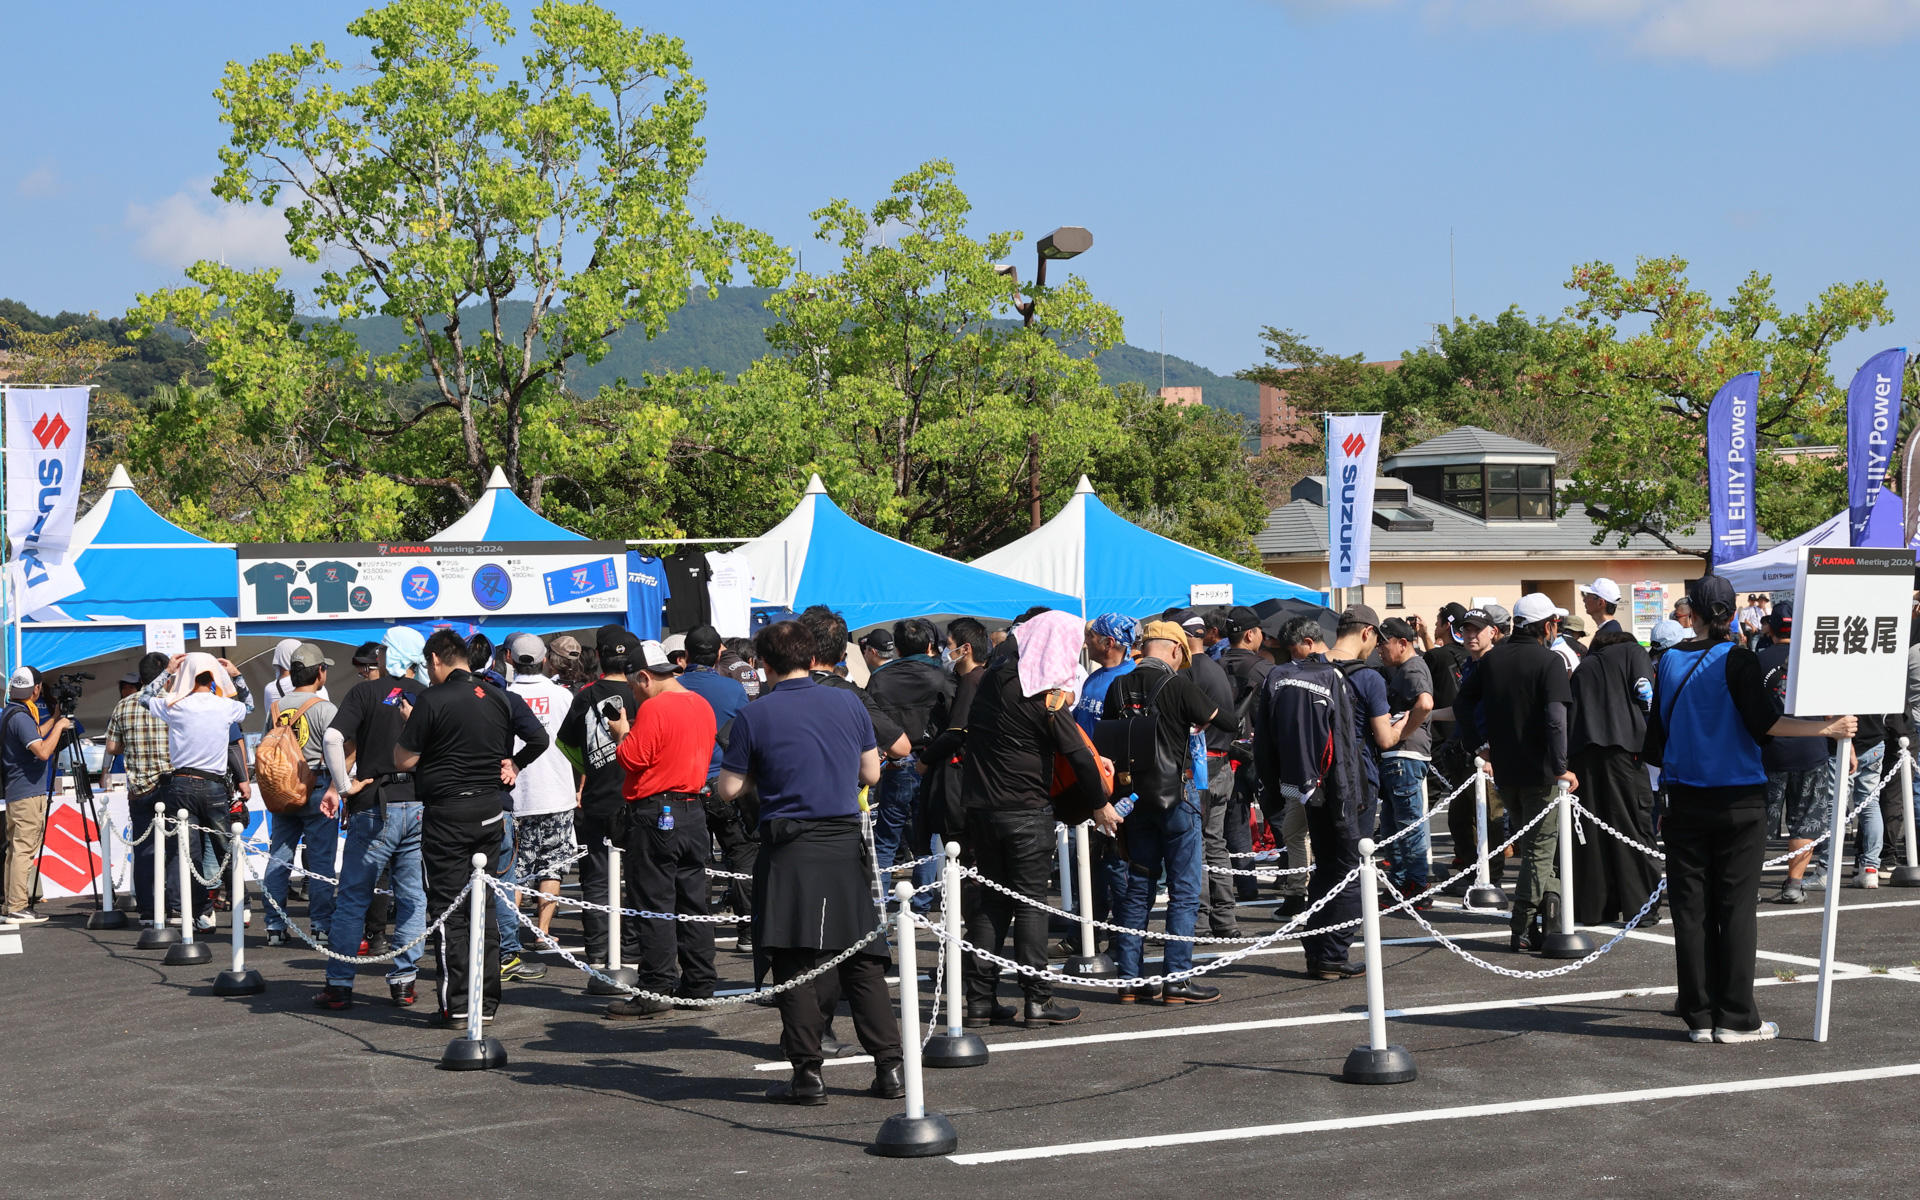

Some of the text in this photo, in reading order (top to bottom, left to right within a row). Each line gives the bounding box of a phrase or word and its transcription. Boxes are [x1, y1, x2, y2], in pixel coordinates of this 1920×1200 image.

[1869, 373, 1892, 445] Power
[1727, 396, 1747, 463] Power
[1340, 464, 1358, 573] SUZUKI
[390, 545, 432, 553] KATANA
[433, 545, 474, 554] Meeting
[475, 545, 504, 553] 2024
[1822, 557, 1856, 565] KATANA
[1856, 558, 1889, 568] Meeting
[1890, 558, 1914, 567] 2024
[1194, 591, 1229, 599] オートリメッサ
[204, 625, 232, 639] 会計
[1812, 615, 1899, 655] 最後尾
